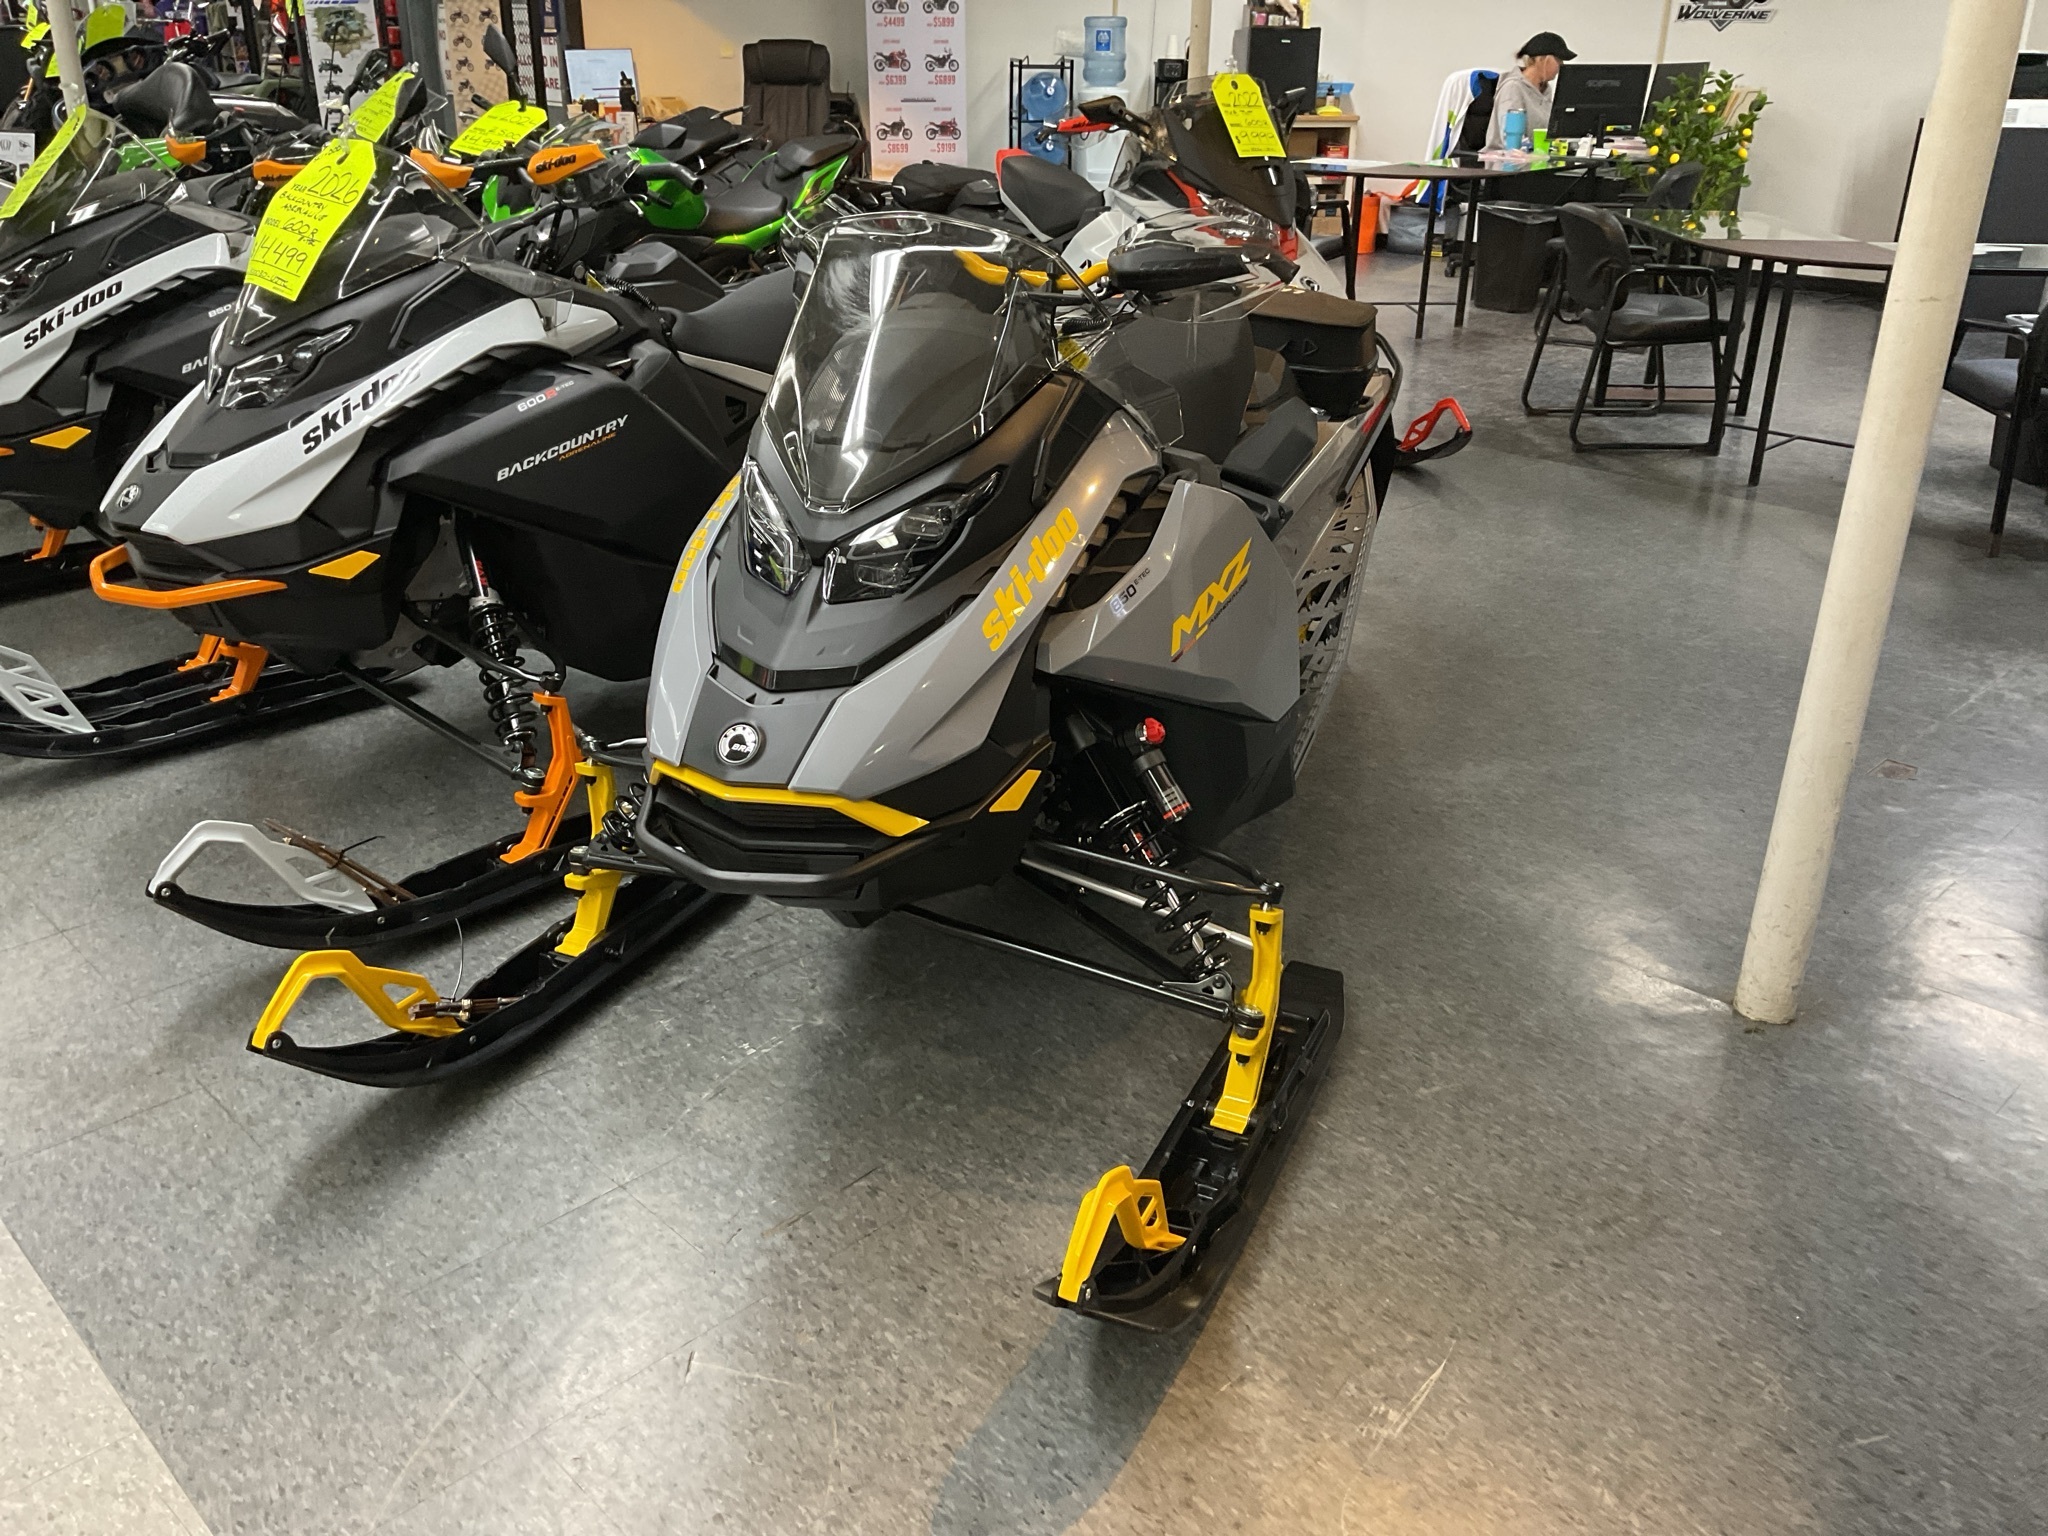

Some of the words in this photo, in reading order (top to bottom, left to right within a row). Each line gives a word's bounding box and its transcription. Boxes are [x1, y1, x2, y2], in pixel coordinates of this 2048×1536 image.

[1677, 5, 1772, 20] WOLVERINE
[936, 142, 957, 153] $9199
[307, 165, 360, 204] 2026
[24, 280, 123, 350] ski-doo
[496, 414, 629, 482] BACKCOUNTRY
[558, 431, 618, 462] ADRENALINE
[982, 507, 1079, 652] ski-doo
[1133, 567, 1151, 586] E-TEC
